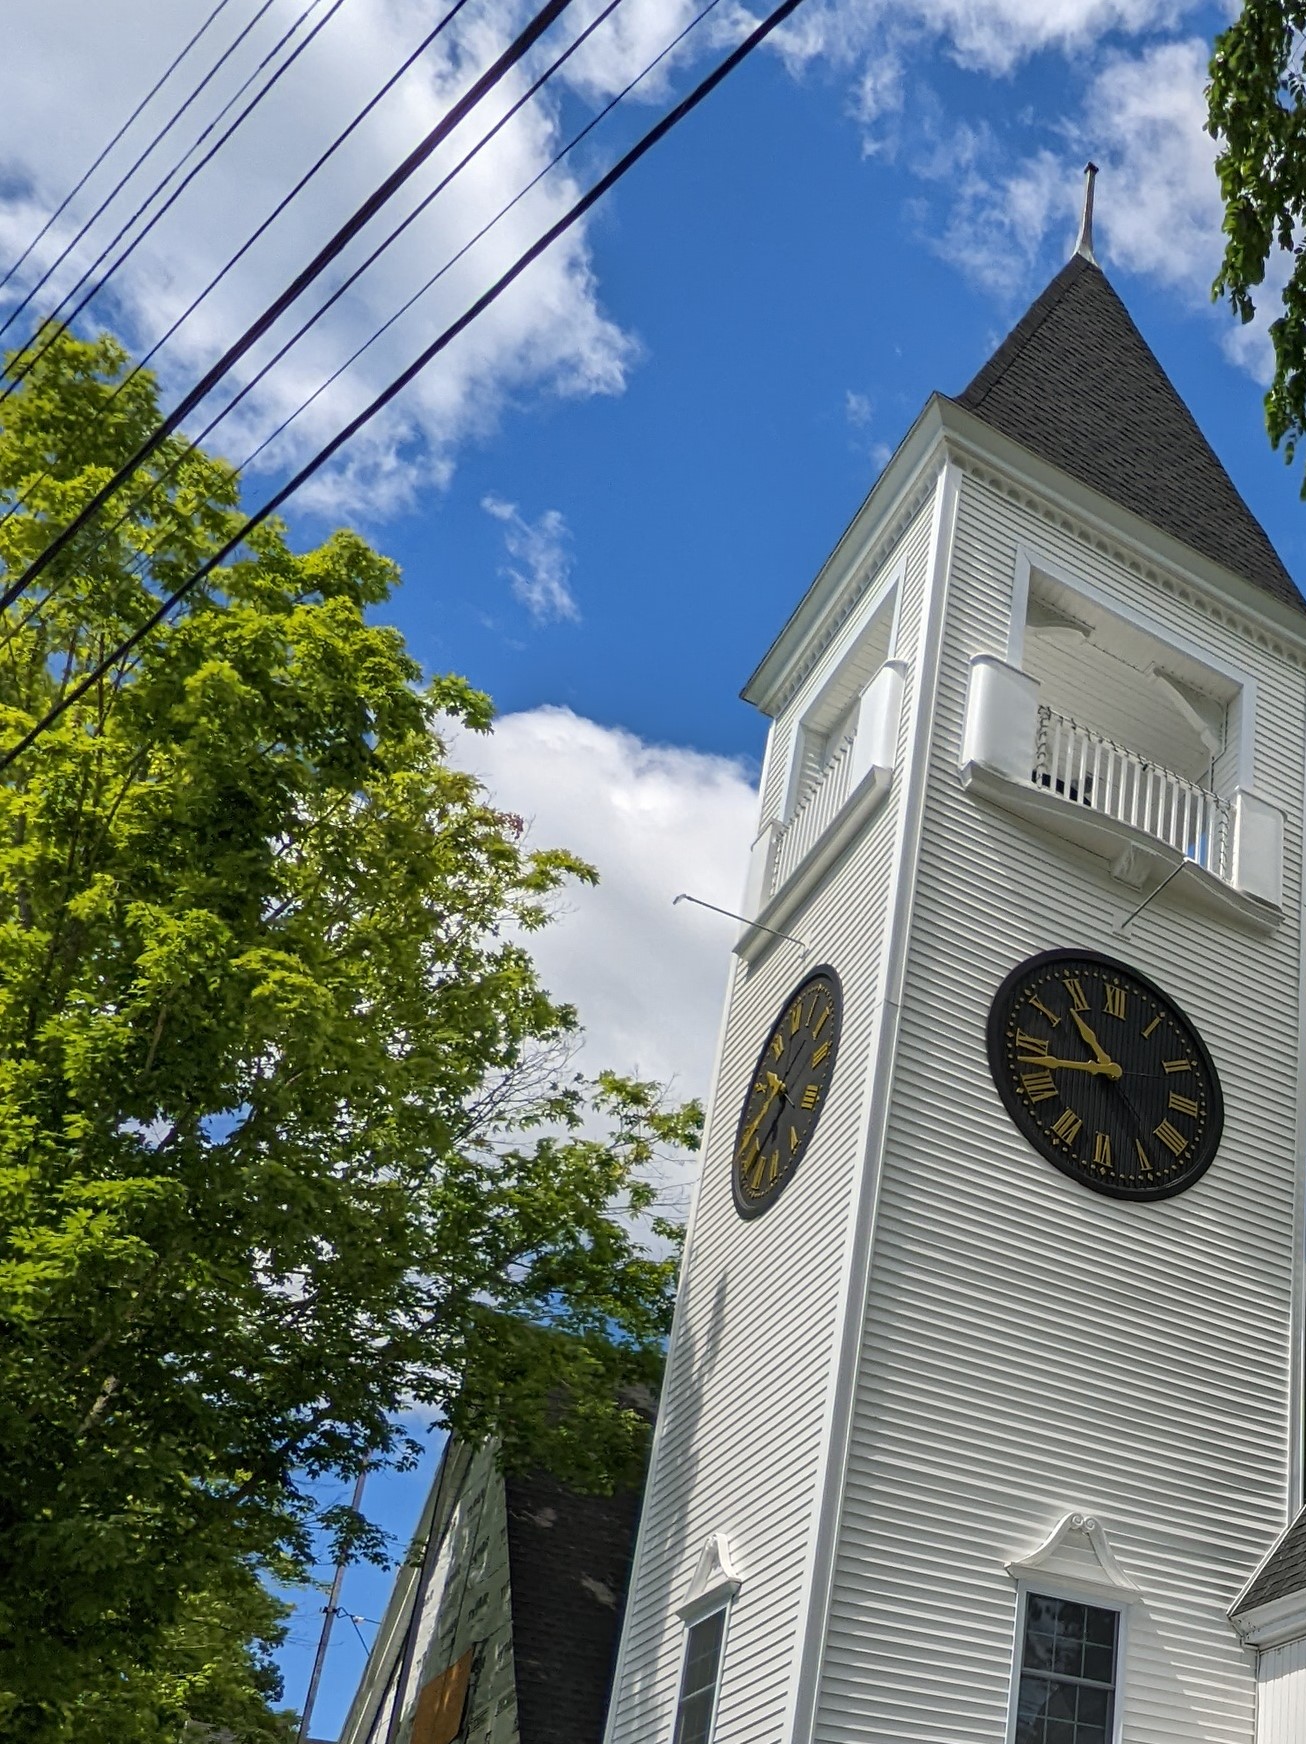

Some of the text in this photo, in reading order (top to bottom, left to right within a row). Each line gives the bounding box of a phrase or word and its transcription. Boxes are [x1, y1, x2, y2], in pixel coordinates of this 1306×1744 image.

[1029, 995, 1061, 1027] X
[1063, 979, 1090, 1011] XI
[1103, 983, 1127, 1021] XII
[1142, 1017, 1162, 1039] I
[1162, 1059, 1192, 1074] II
[1020, 1071, 1058, 1104] VIII
[1169, 1091, 1198, 1117] III
[1050, 1107, 1083, 1147] VII
[1153, 1118, 1188, 1156] IIII
[1093, 1132, 1113, 1168] VI
[1136, 1139, 1153, 1171] V
